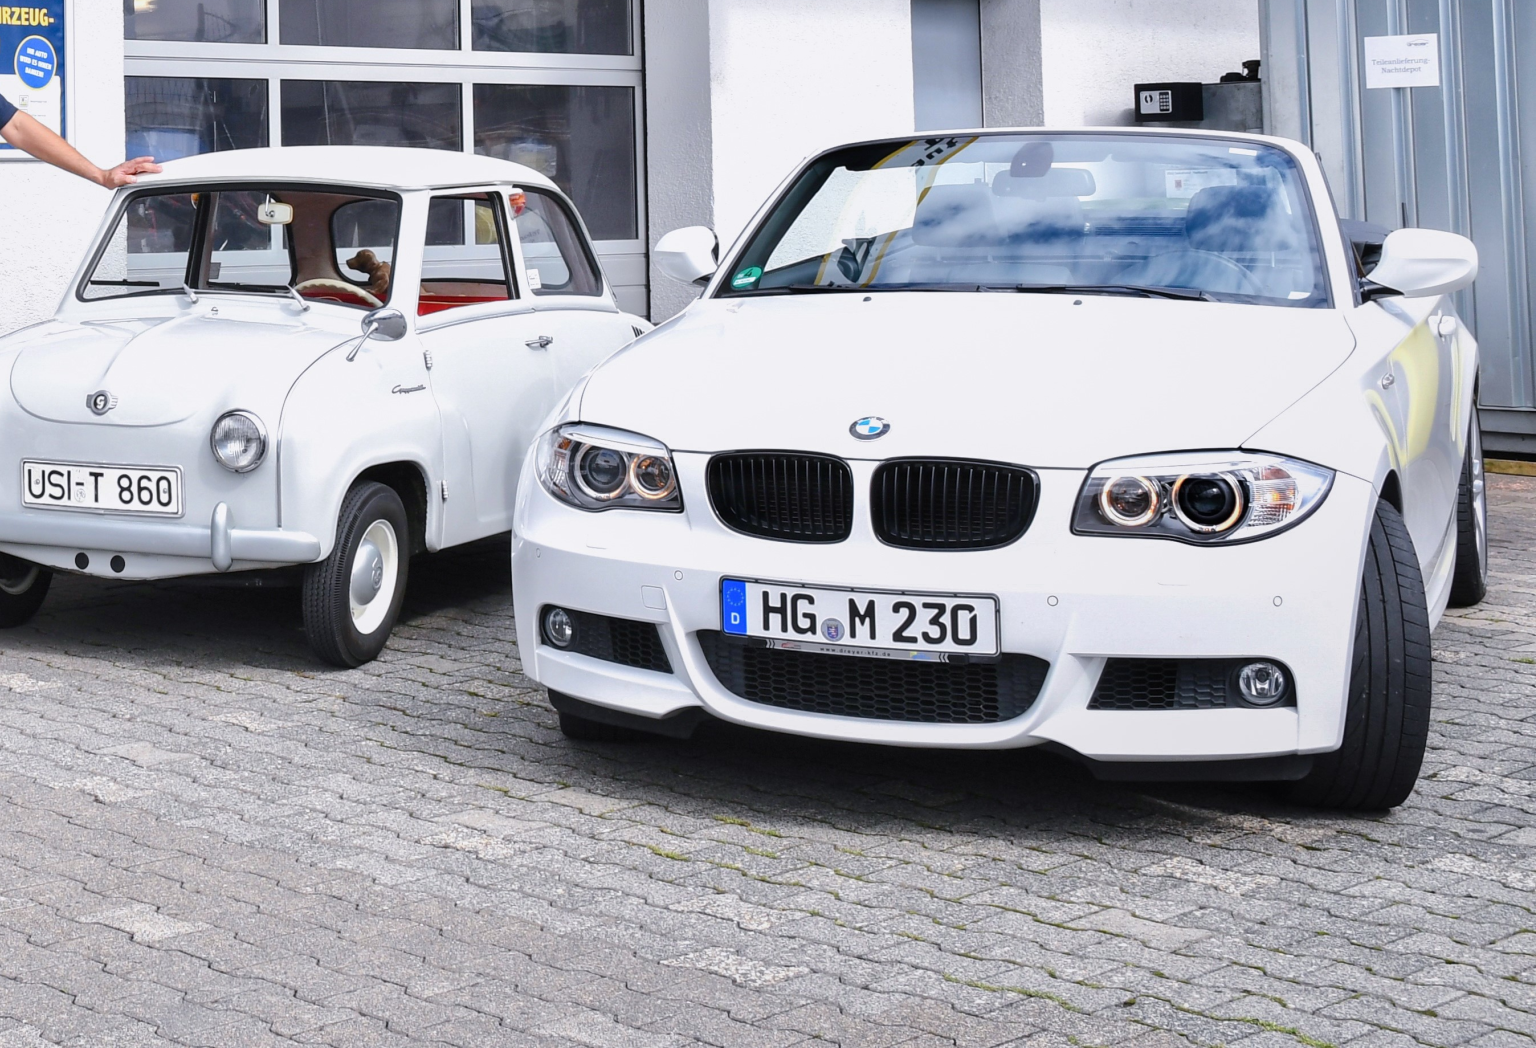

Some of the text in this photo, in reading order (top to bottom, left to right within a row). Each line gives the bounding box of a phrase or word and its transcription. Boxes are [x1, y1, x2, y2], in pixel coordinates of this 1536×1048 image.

[116, 474, 173, 507] 860
[730, 590, 977, 646] D HG M 230
